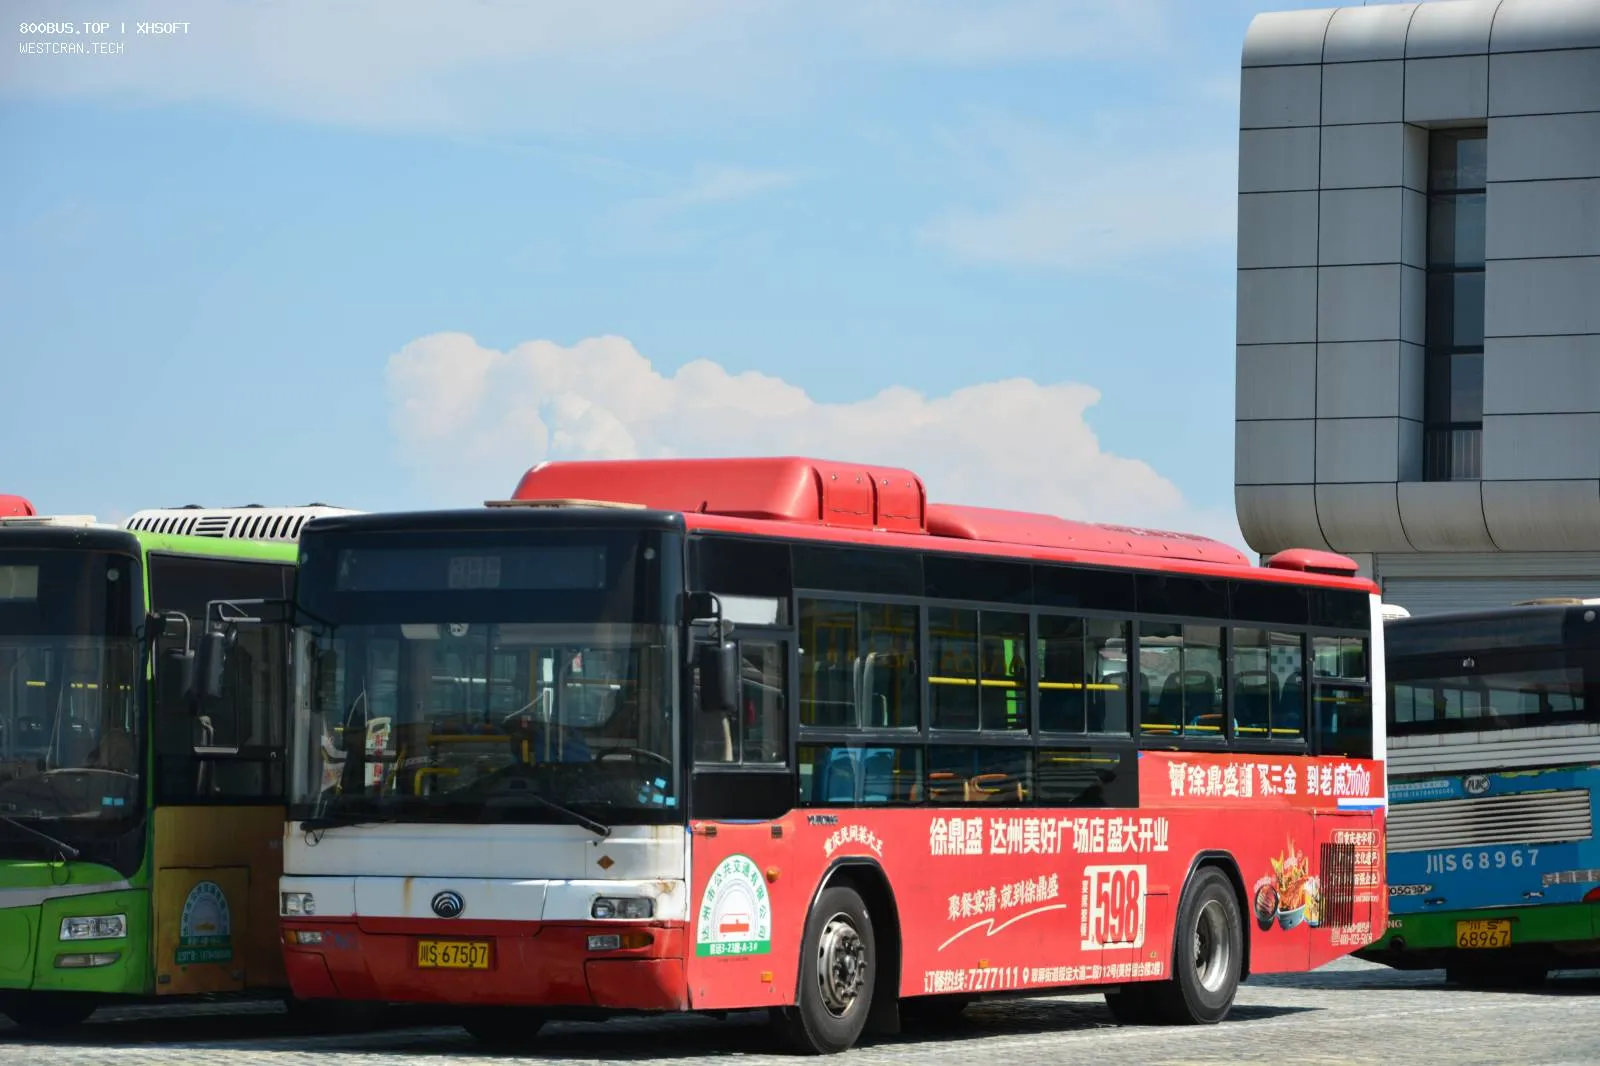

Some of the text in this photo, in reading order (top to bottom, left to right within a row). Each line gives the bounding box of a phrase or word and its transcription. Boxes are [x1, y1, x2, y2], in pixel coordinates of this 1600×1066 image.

[929, 817, 1168, 856] 徐鼎盛 达州美好广场店盛大开业
[1426, 849, 1539, 874] 川S68967
[1095, 869, 1140, 946] 598
[1459, 931, 1509, 948] 68967
